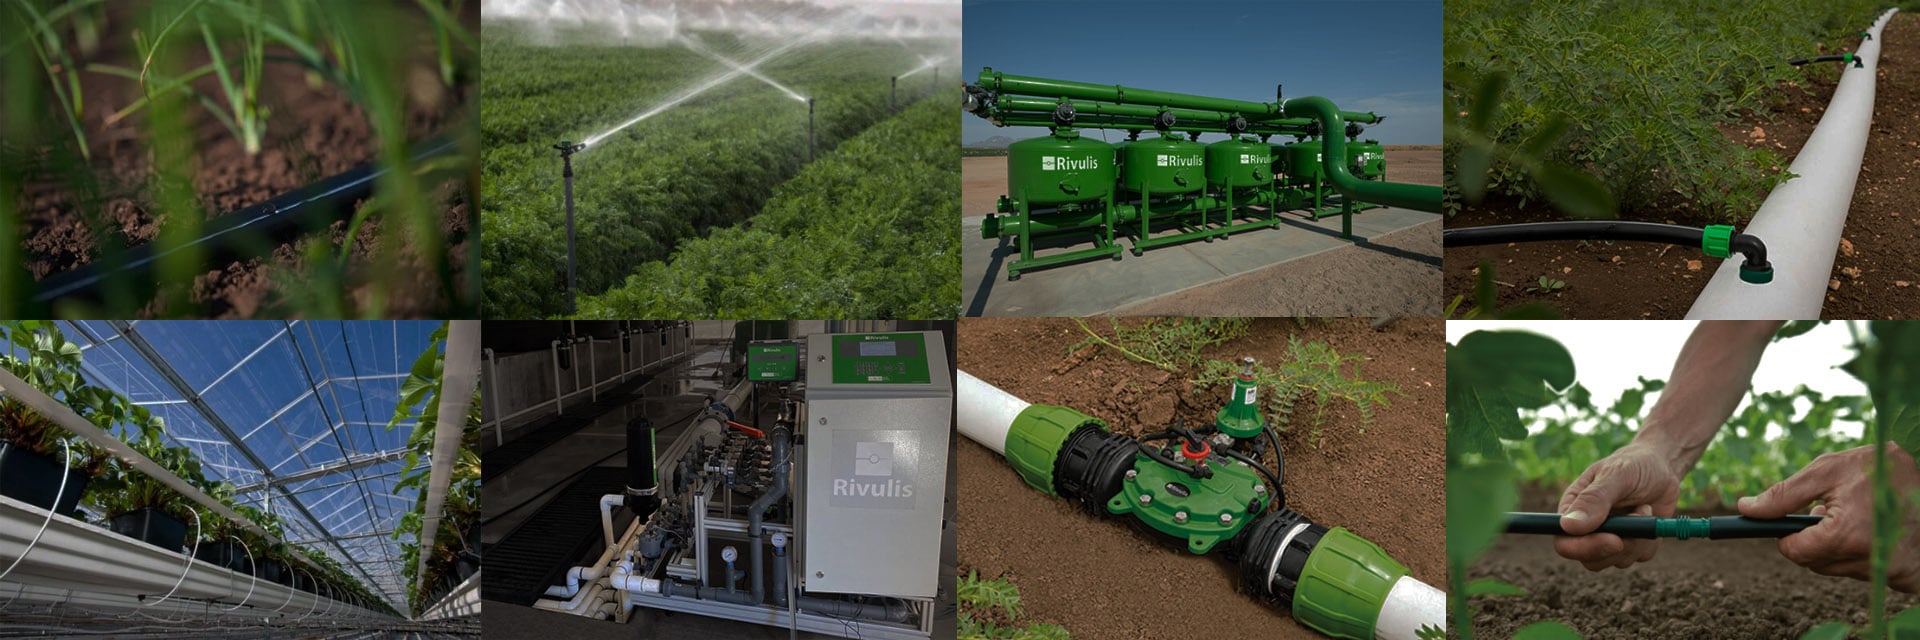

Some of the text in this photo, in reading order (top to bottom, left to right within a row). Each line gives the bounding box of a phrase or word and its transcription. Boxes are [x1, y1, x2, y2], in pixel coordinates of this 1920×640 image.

[1057, 155, 1098, 170] Rivulis
[1169, 154, 1203, 167] Rivulis
[1250, 154, 1271, 164] Rivul
[1370, 152, 1385, 160] Rivul
[833, 478, 913, 497] Rivulis
